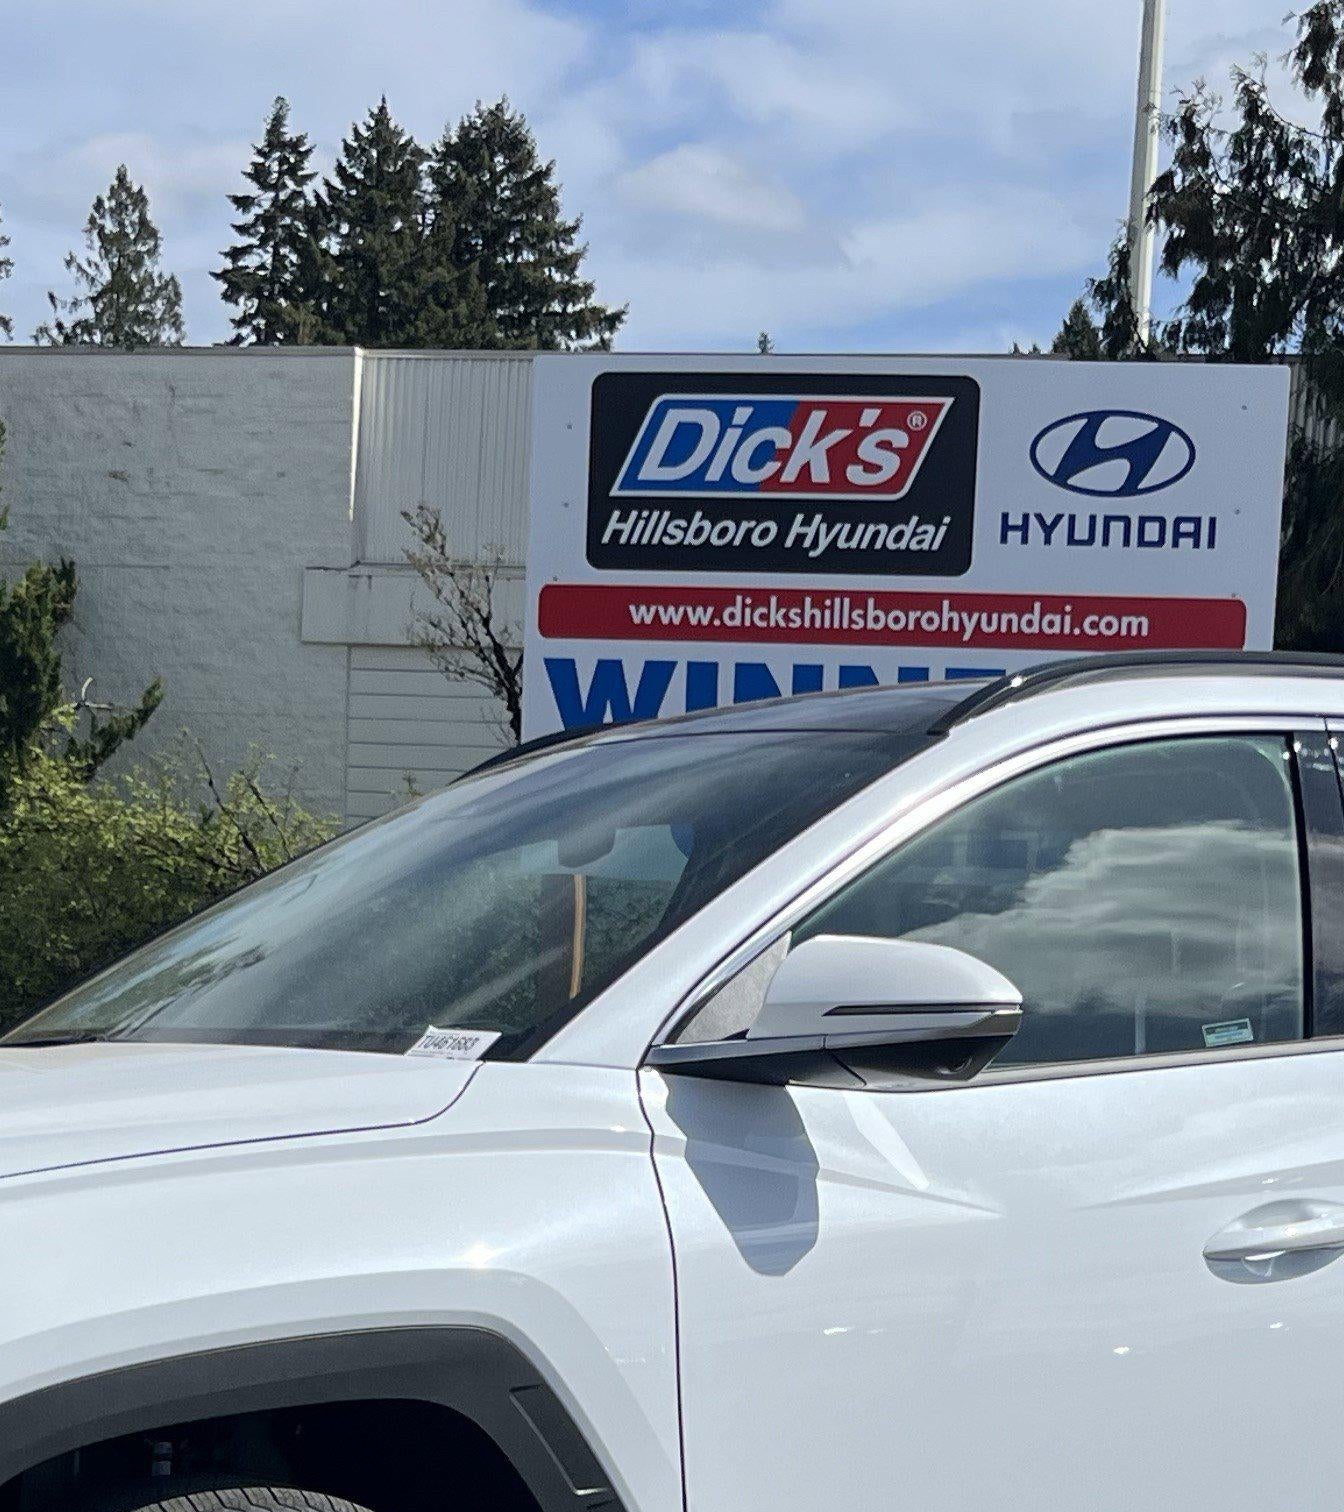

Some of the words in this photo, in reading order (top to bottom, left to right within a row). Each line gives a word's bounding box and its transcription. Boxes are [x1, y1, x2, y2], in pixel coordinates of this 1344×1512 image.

[637, 403, 910, 487] Dick's
[601, 510, 778, 548] Hillsboro
[784, 514, 951, 558] Hyundai
[1000, 511, 1218, 549] HYUNDAI
[629, 596, 1149, 640] www.dickshillsborohyundai.com
